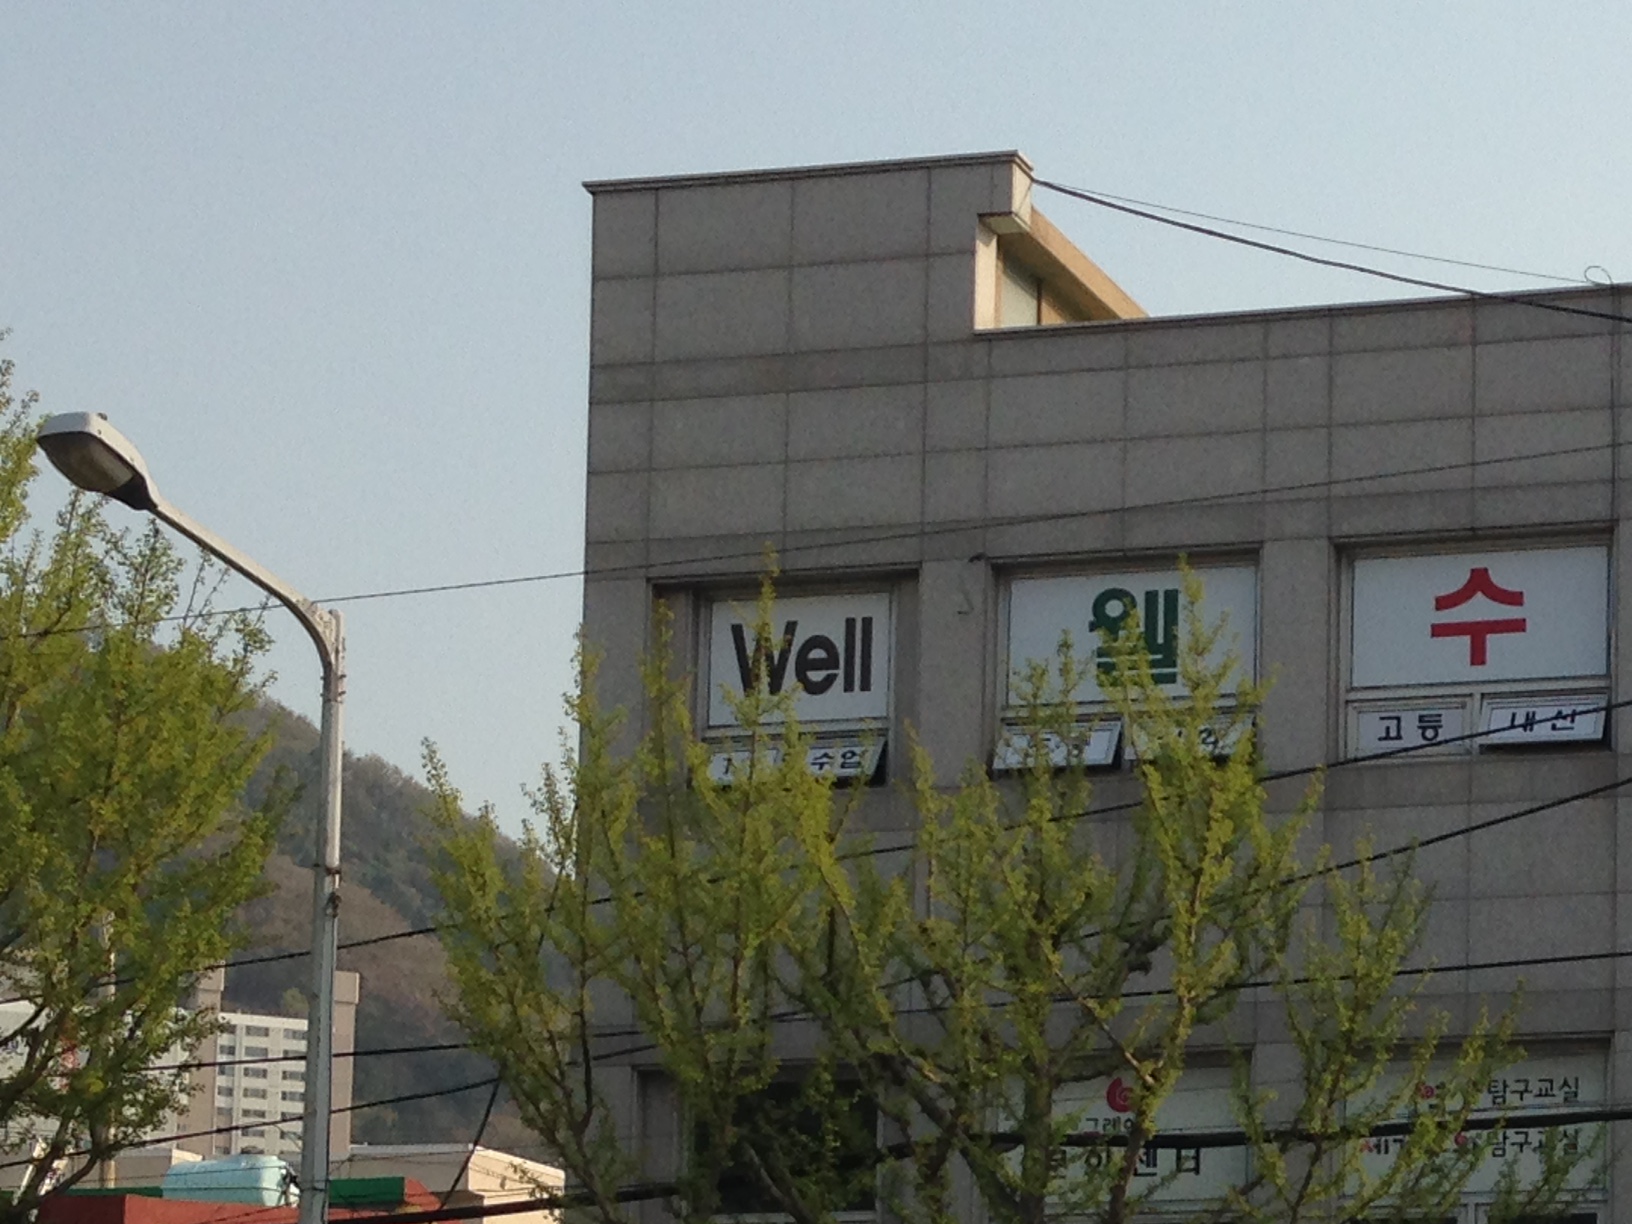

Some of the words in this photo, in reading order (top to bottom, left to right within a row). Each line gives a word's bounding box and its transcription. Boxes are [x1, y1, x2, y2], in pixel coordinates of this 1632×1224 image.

[730, 616, 873, 697] Well
[1088, 588, 1179, 687] 웰
[1431, 567, 1527, 666] 수
[1377, 712, 1444, 742] 고등
[1508, 707, 1578, 732] 내신
